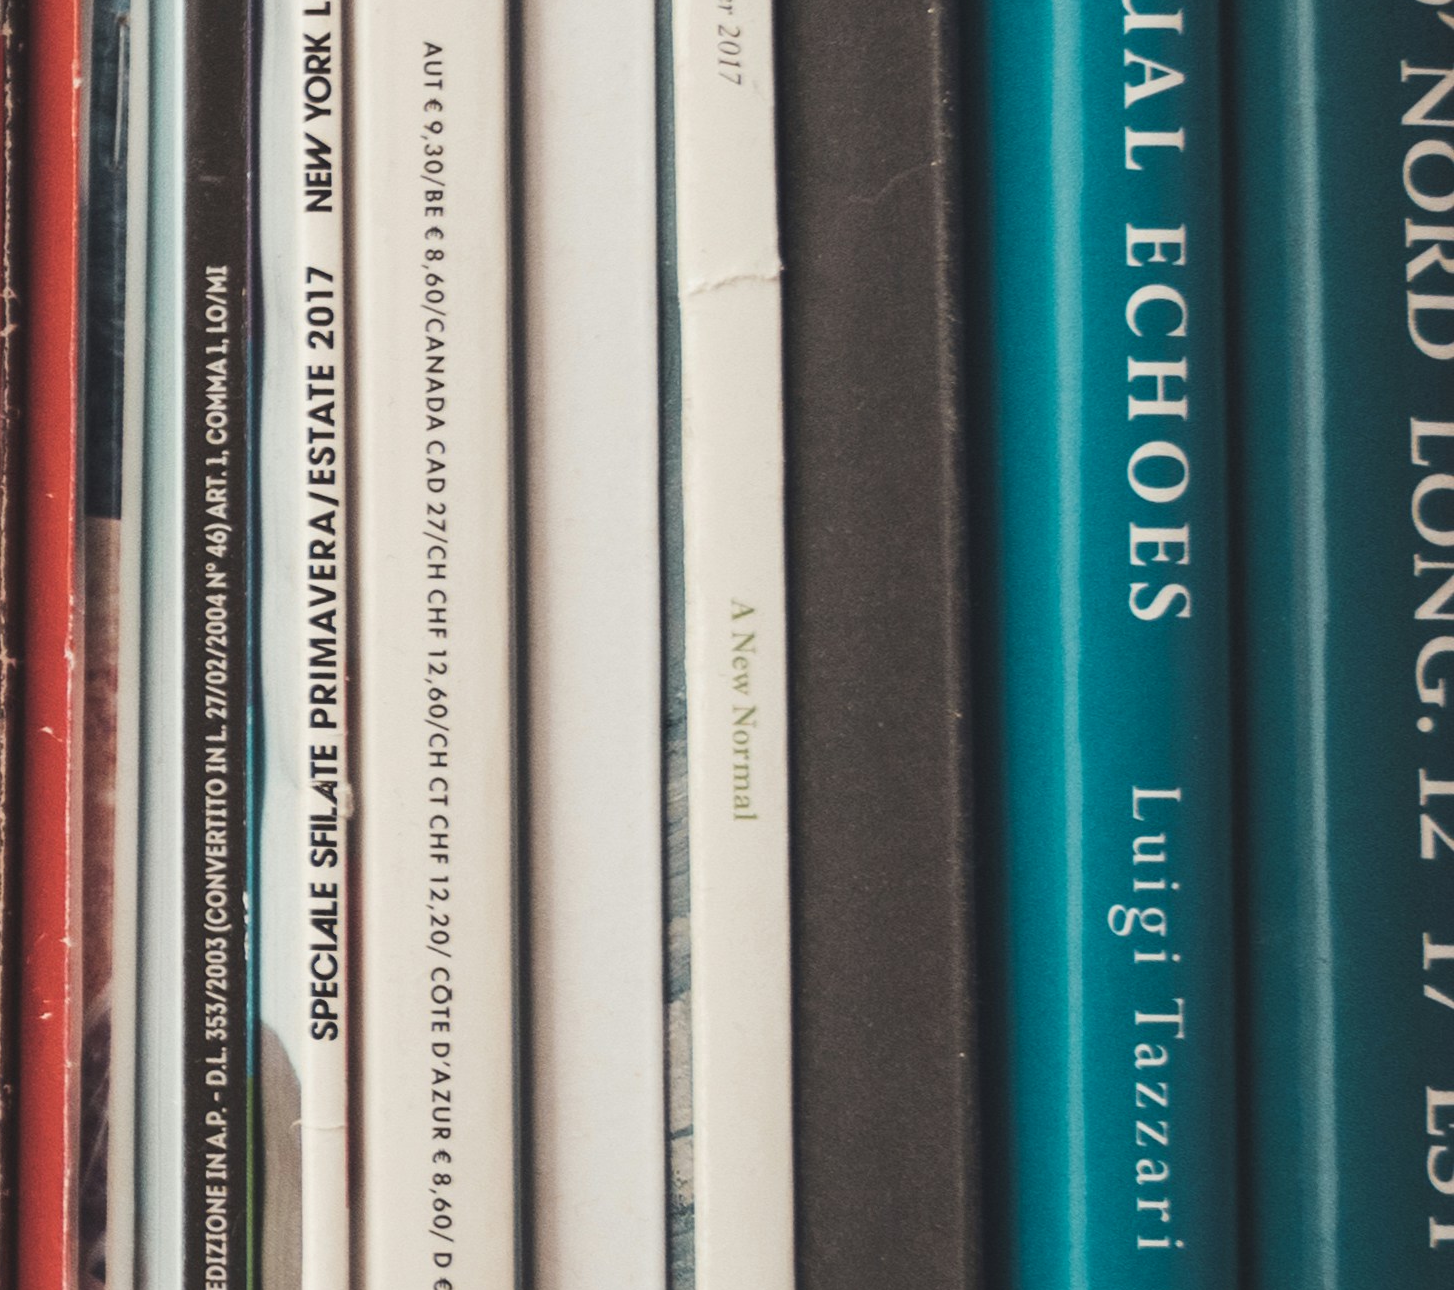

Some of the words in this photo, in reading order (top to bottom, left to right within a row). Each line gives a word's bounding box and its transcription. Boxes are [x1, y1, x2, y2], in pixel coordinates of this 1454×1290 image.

[302, 31, 332, 122] YORK
[716, 23, 743, 86] 2017
[303, 131, 333, 213] NEW
[1400, 61, 1454, 361] NORD
[204, 264, 228, 334] LO/MI
[305, 265, 335, 350] 2017
[204, 357, 228, 445] COMMA
[1124, 223, 1192, 623] ECHOES
[204, 470, 228, 520] ART.
[202, 521, 233, 558] 46)
[306, 364, 340, 729] PRIMAVERA/ESTATE
[1407, 417, 1454, 735] LONG.
[730, 599, 756, 621] A
[203, 592, 228, 719] 27/02/2004
[730, 631, 756, 695] New
[204, 723, 227, 742] L.
[204, 746, 228, 774] IN
[731, 704, 759, 820] Normal
[308, 744, 338, 868] SFILATE
[202, 777, 233, 933] (CONVERTITO
[1107, 784, 1184, 966] Luigi
[204, 936, 228, 1041] 353/2003
[309, 881, 339, 1041] SPECIALE
[204, 1045, 228, 1086] D.L.
[204, 1106, 228, 1150] A.P.
[204, 1152, 228, 1180] IN
[1131, 1000, 1187, 1252] Tazzari
